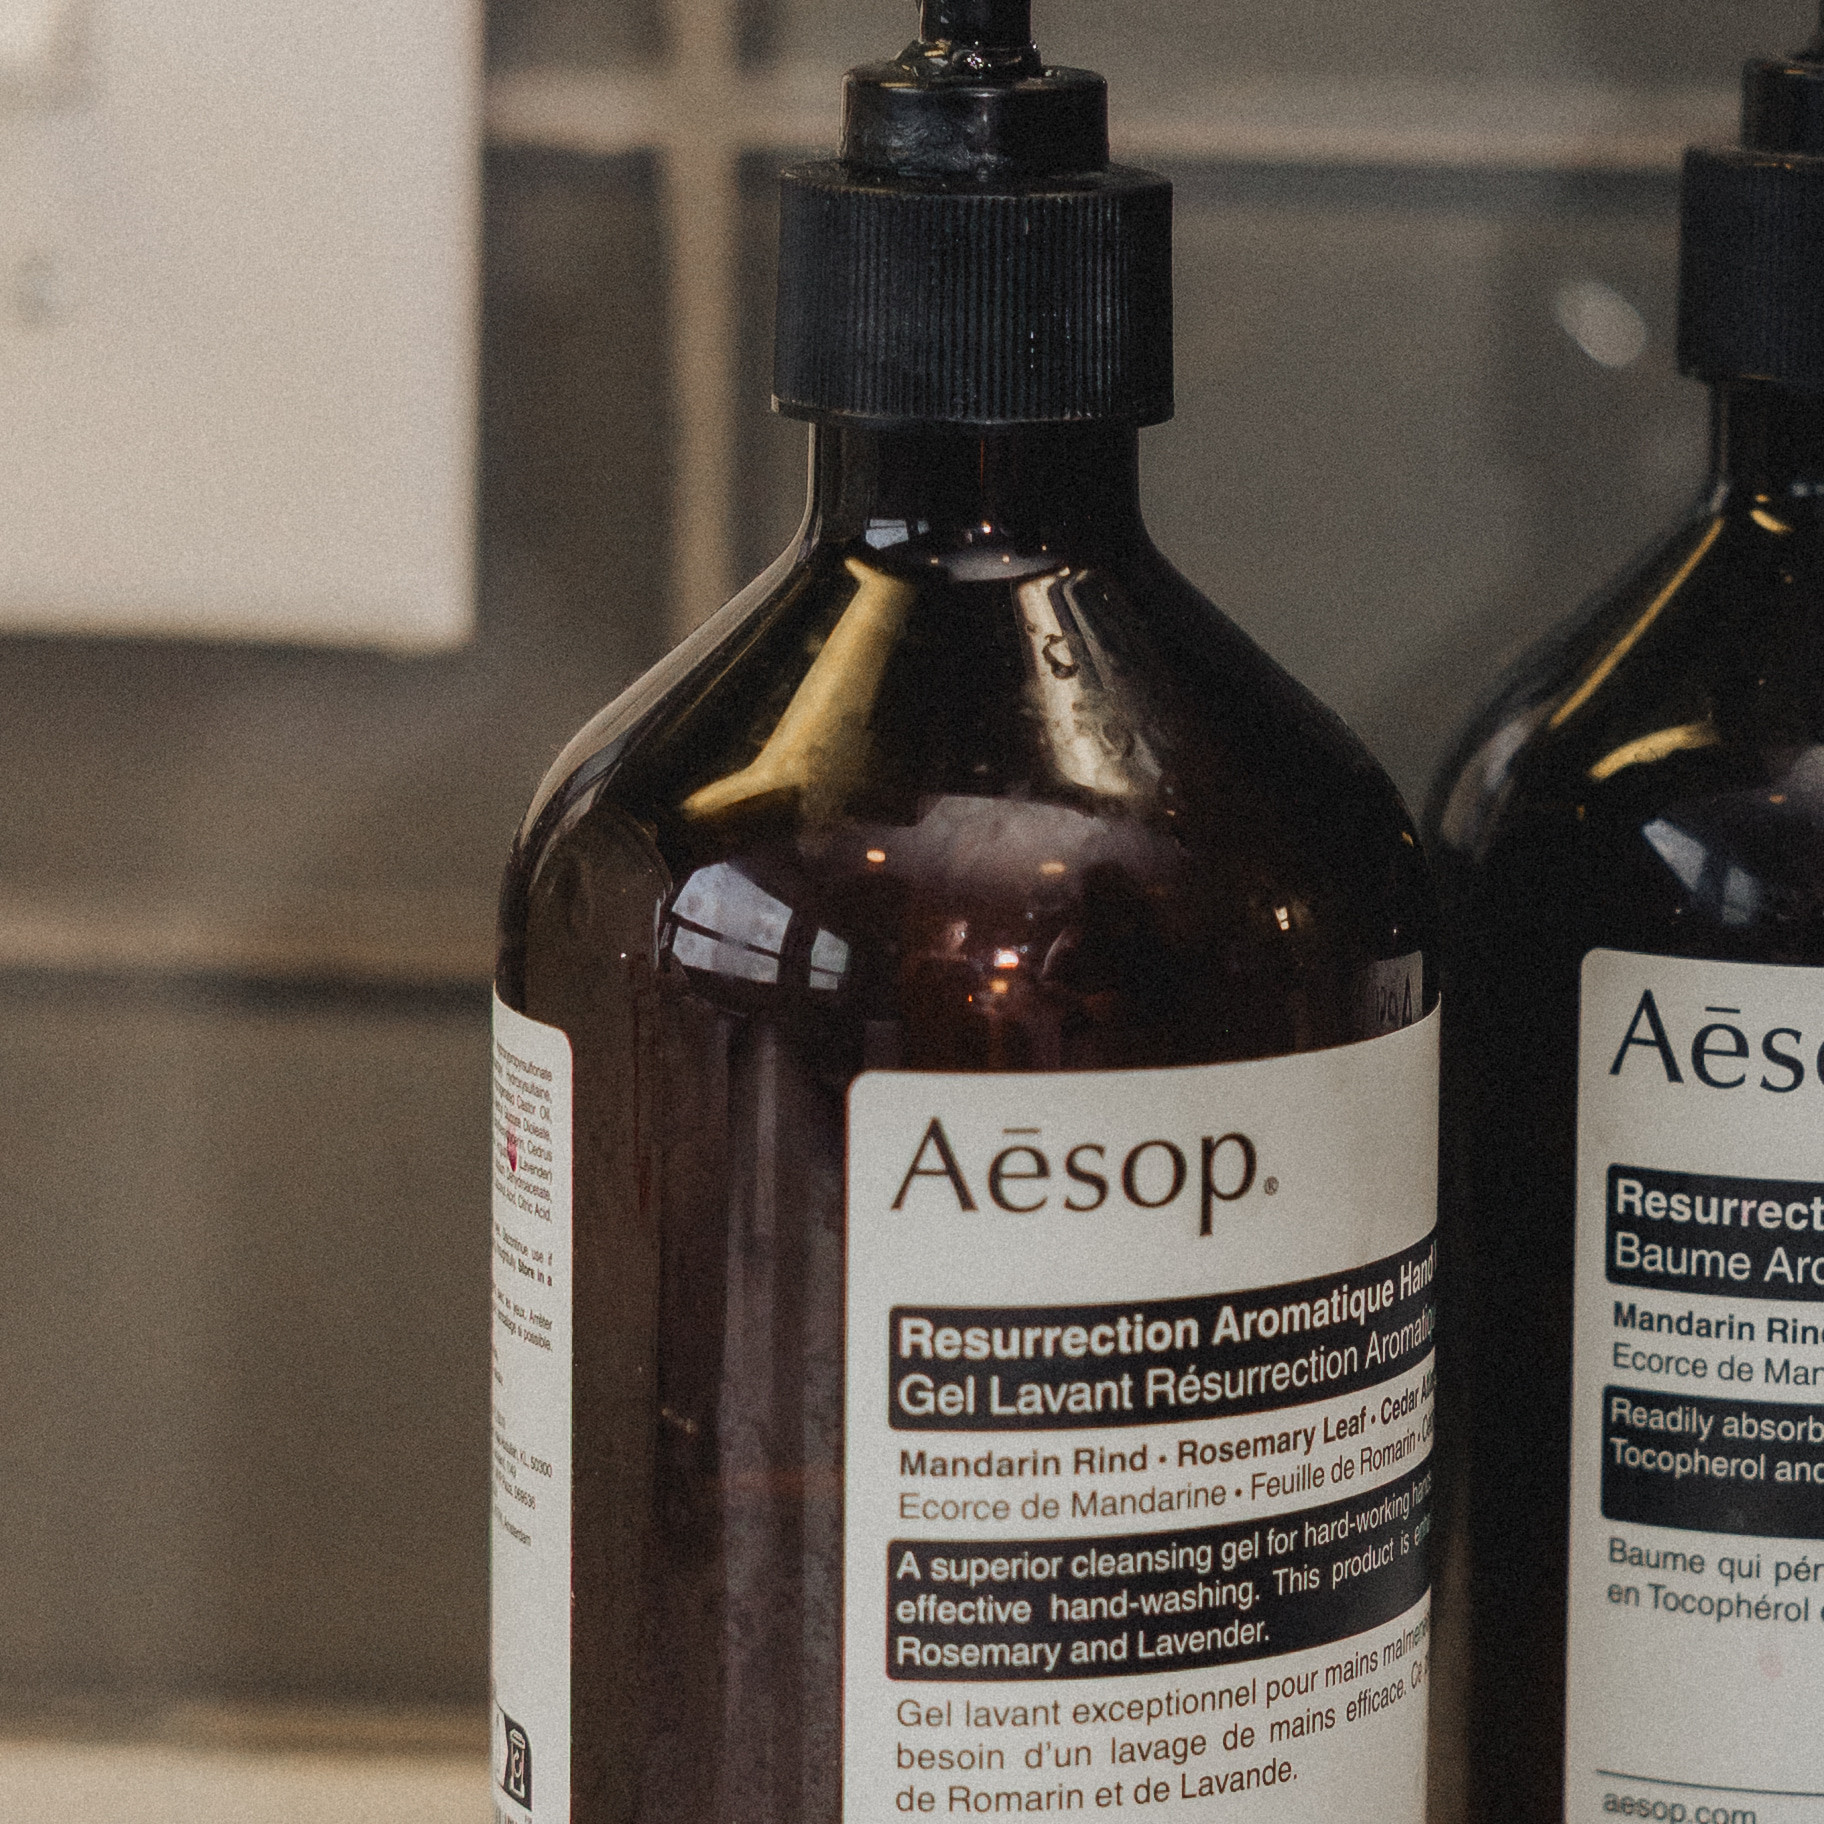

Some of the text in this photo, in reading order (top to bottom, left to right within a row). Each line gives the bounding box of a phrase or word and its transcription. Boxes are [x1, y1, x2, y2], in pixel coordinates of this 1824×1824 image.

[1615, 1232, 1752, 1281] Baume
[899, 1243, 1434, 1360] Resurrection Aromatique Hand
[1613, 1300, 1755, 1342] Mandarin
[898, 1372, 975, 1416] Gel
[990, 1372, 1134, 1416] Lavant
[1146, 1344, 1359, 1408] Résurrection
[1612, 1342, 1708, 1378] Ecorce
[1717, 1355, 1754, 1382] de
[900, 1449, 1061, 1478] Mandarin
[1073, 1443, 1148, 1475] Rind
[1177, 1425, 1317, 1468] Rosemary
[1322, 1405, 1368, 1445] Leaf
[1380, 1386, 1420, 1426] Cedar
[1609, 1396, 1715, 1442] Readily
[899, 1428, 1416, 1520] Ecorce de Mandarine Feuille de Romarin
[1609, 1437, 1766, 1481] Tocopherol
[896, 1550, 922, 1580] A
[930, 1550, 1064, 1588] superior
[1071, 1542, 1212, 1578] cleansing
[1220, 1531, 1260, 1572] gel
[1267, 1527, 1299, 1556] for
[1304, 1491, 1410, 1549] hard-working
[1608, 1537, 1706, 1574] Baume
[1717, 1554, 1761, 1584] qui
[896, 1593, 1032, 1624] effective
[1051, 1579, 1260, 1622] hand-washing.
[1272, 1562, 1320, 1596] This
[1332, 1538, 1395, 1590] product
[1400, 1529, 1410, 1556] is
[1606, 1582, 1640, 1607] en
[1648, 1582, 1810, 1623] Tocophérol
[896, 1619, 1270, 1672] Rosemary and Lavender.
[896, 1698, 951, 1727] Gel
[966, 1700, 1061, 1727] lavant
[1072, 1678, 1257, 1726] exceptionnel
[1266, 1669, 1319, 1709] pour
[1325, 1650, 1379, 1688] mains
[896, 1742, 1005, 1770] besoin
[1024, 1742, 1092, 1768] d'un
[1110, 1733, 1207, 1766] lavage
[1223, 1723, 1255, 1751] de
[1270, 1706, 1337, 1742] mains
[1346, 1676, 1407, 1722] efficace.
[896, 1757, 1298, 1813] de Romarin et de Lavande.
